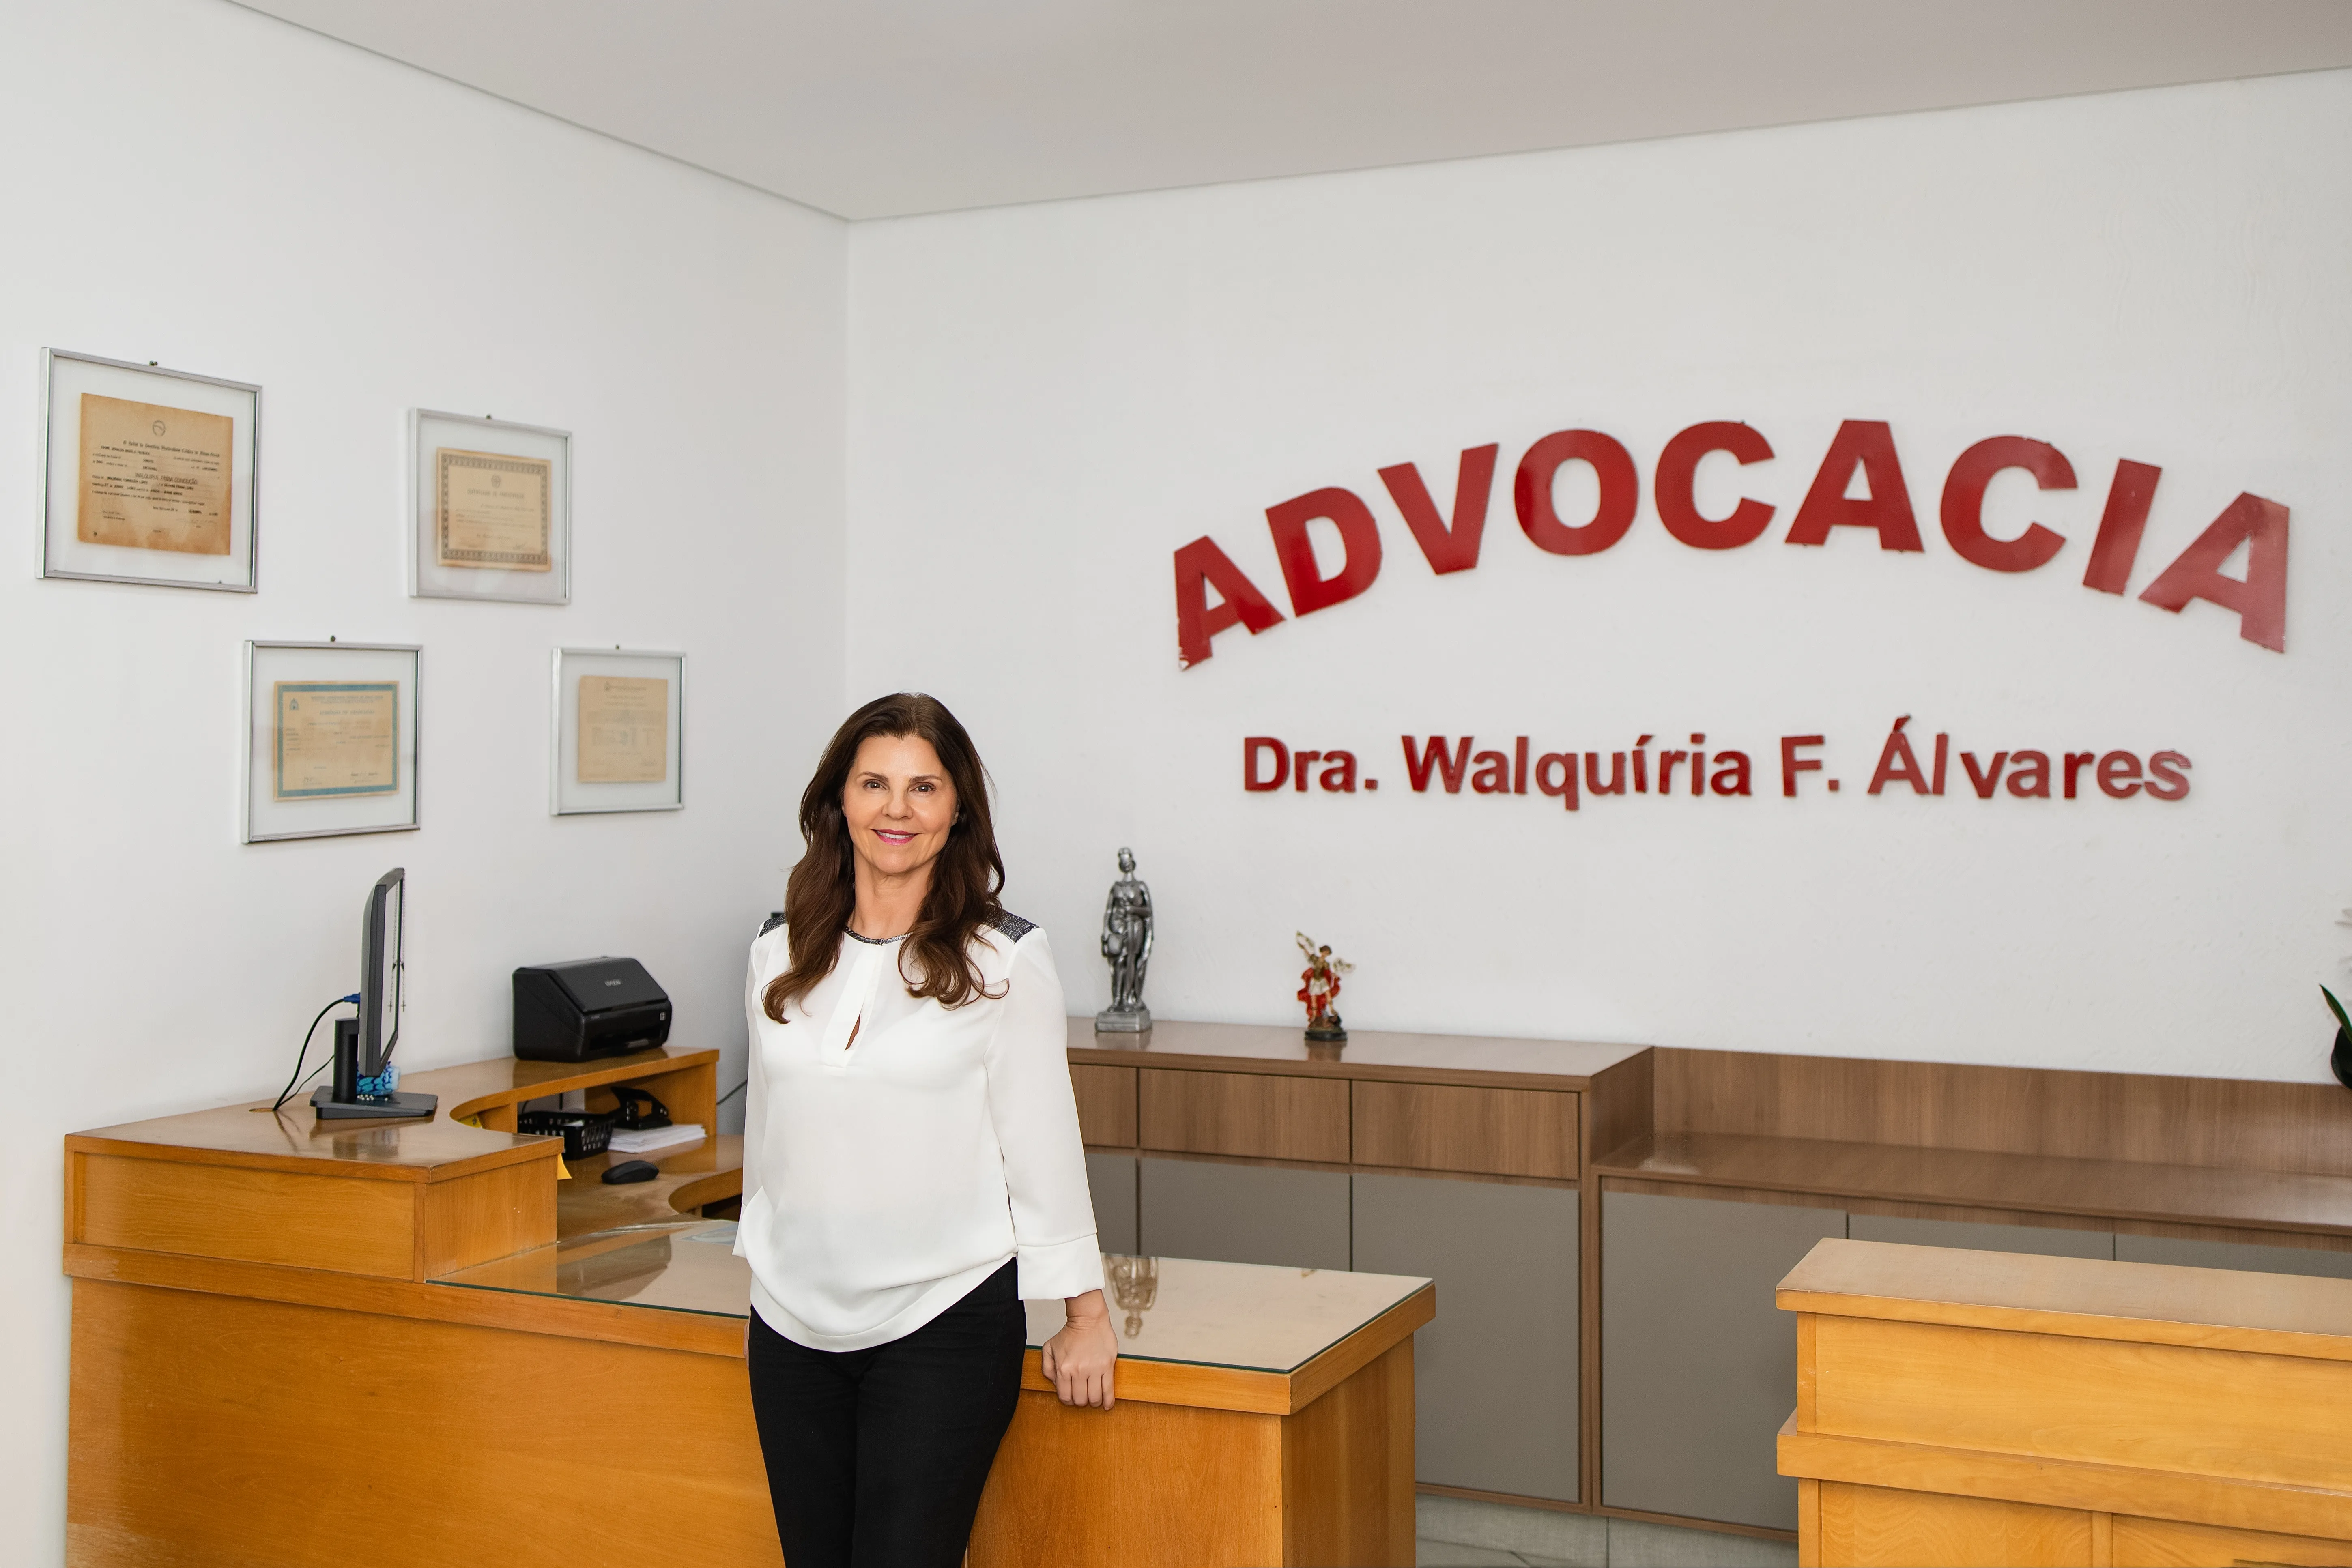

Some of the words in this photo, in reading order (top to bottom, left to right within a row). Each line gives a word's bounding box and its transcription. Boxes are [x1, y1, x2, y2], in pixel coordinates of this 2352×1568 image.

[1173, 419, 2291, 669] ADVOCACIA
[1243, 736, 1377, 793] Dra.
[1401, 732, 1752, 811] Walquíria
[1780, 734, 1839, 797] F.
[1867, 716, 2193, 801] Álvares
